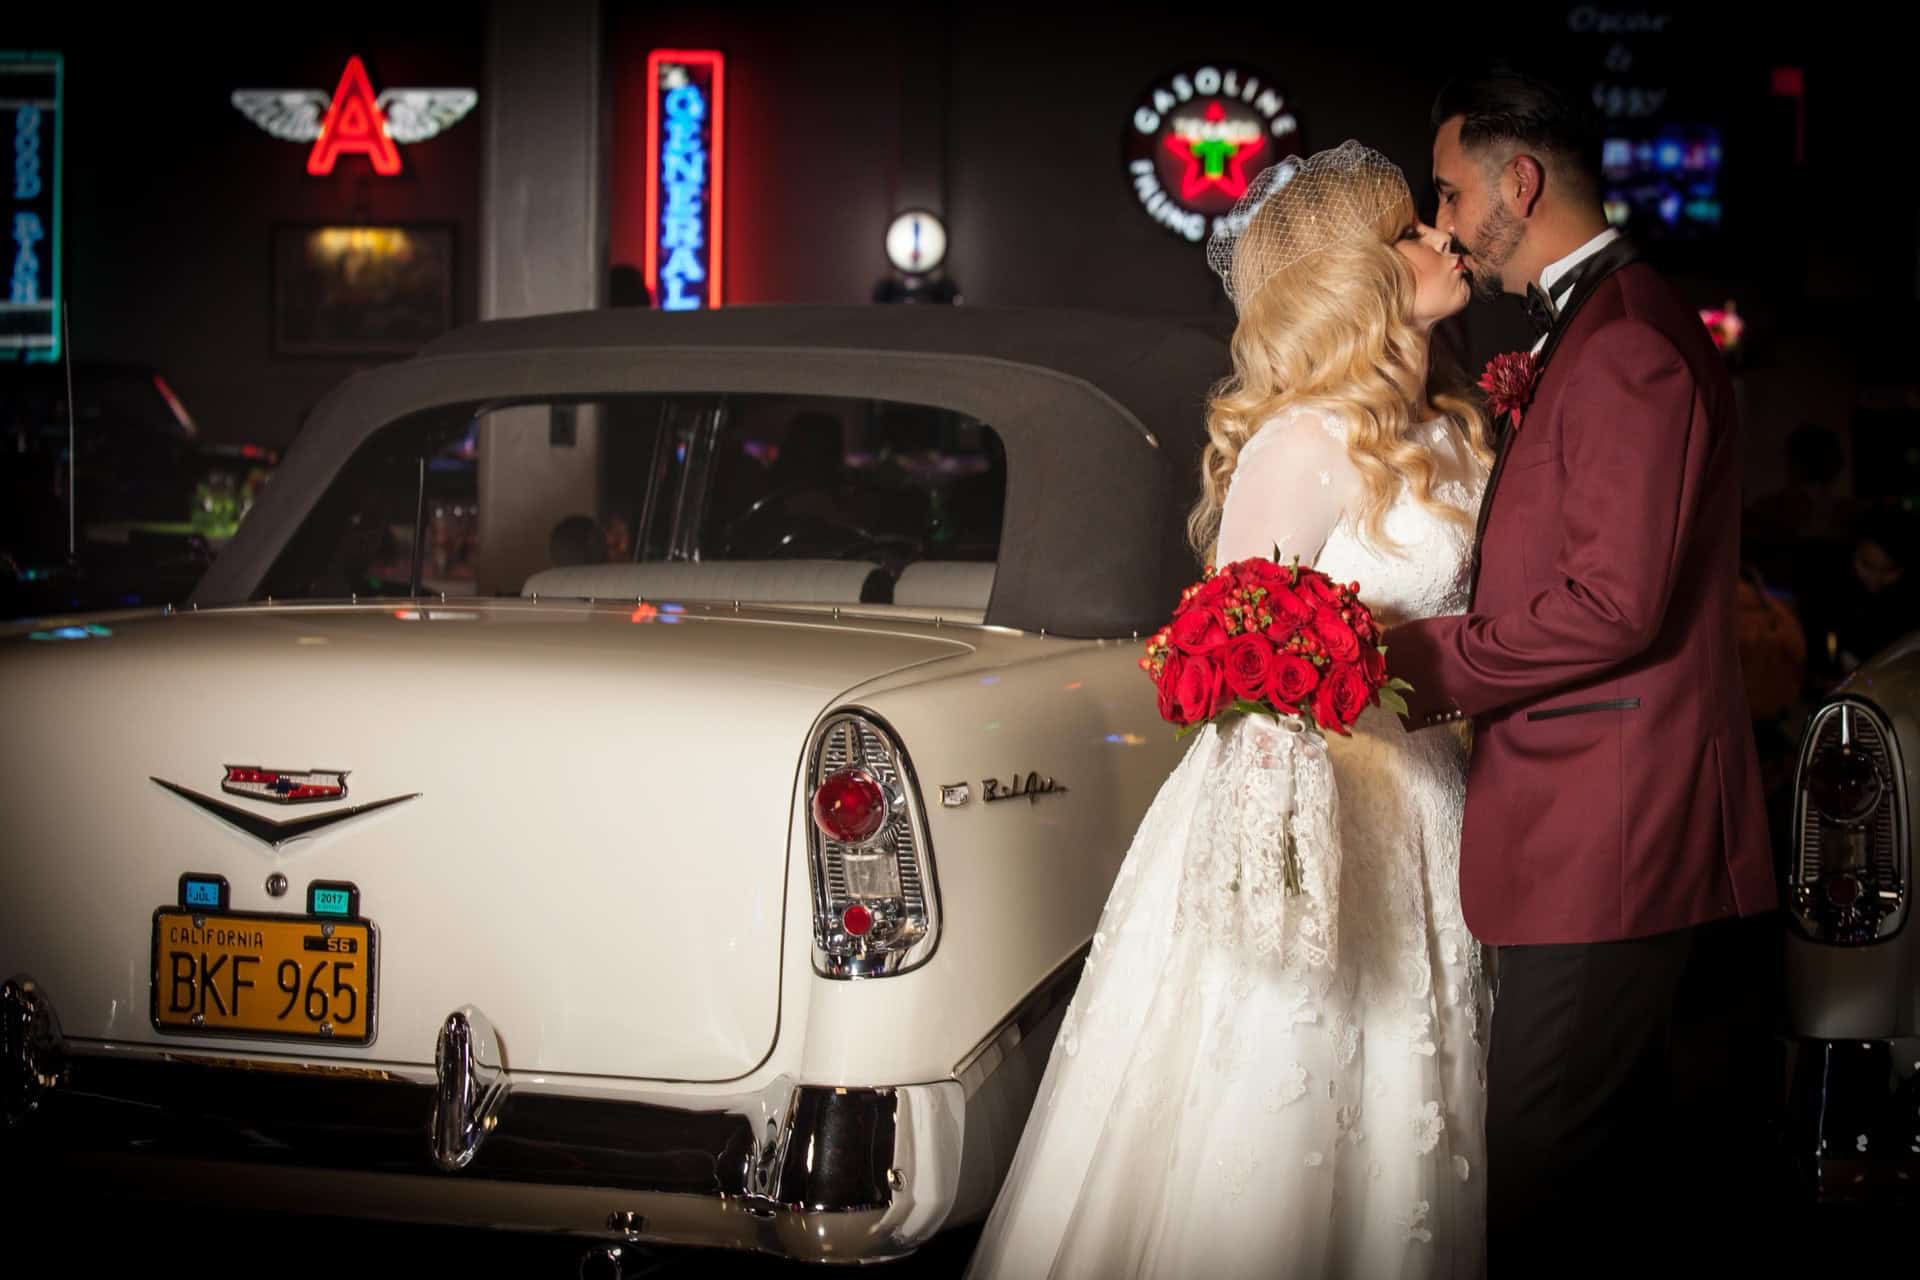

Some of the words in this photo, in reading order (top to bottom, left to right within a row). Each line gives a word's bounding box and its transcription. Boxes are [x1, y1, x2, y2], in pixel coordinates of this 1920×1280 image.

[307, 55, 402, 175] A
[1134, 66, 1297, 137] GASOLINE
[660, 85, 706, 310] GENERAL
[319, 893, 343, 905] 2017
[169, 927, 264, 948] CALIFORNIA
[327, 937, 351, 952] 56
[168, 951, 263, 1017] BKF
[277, 958, 358, 1025] 965
